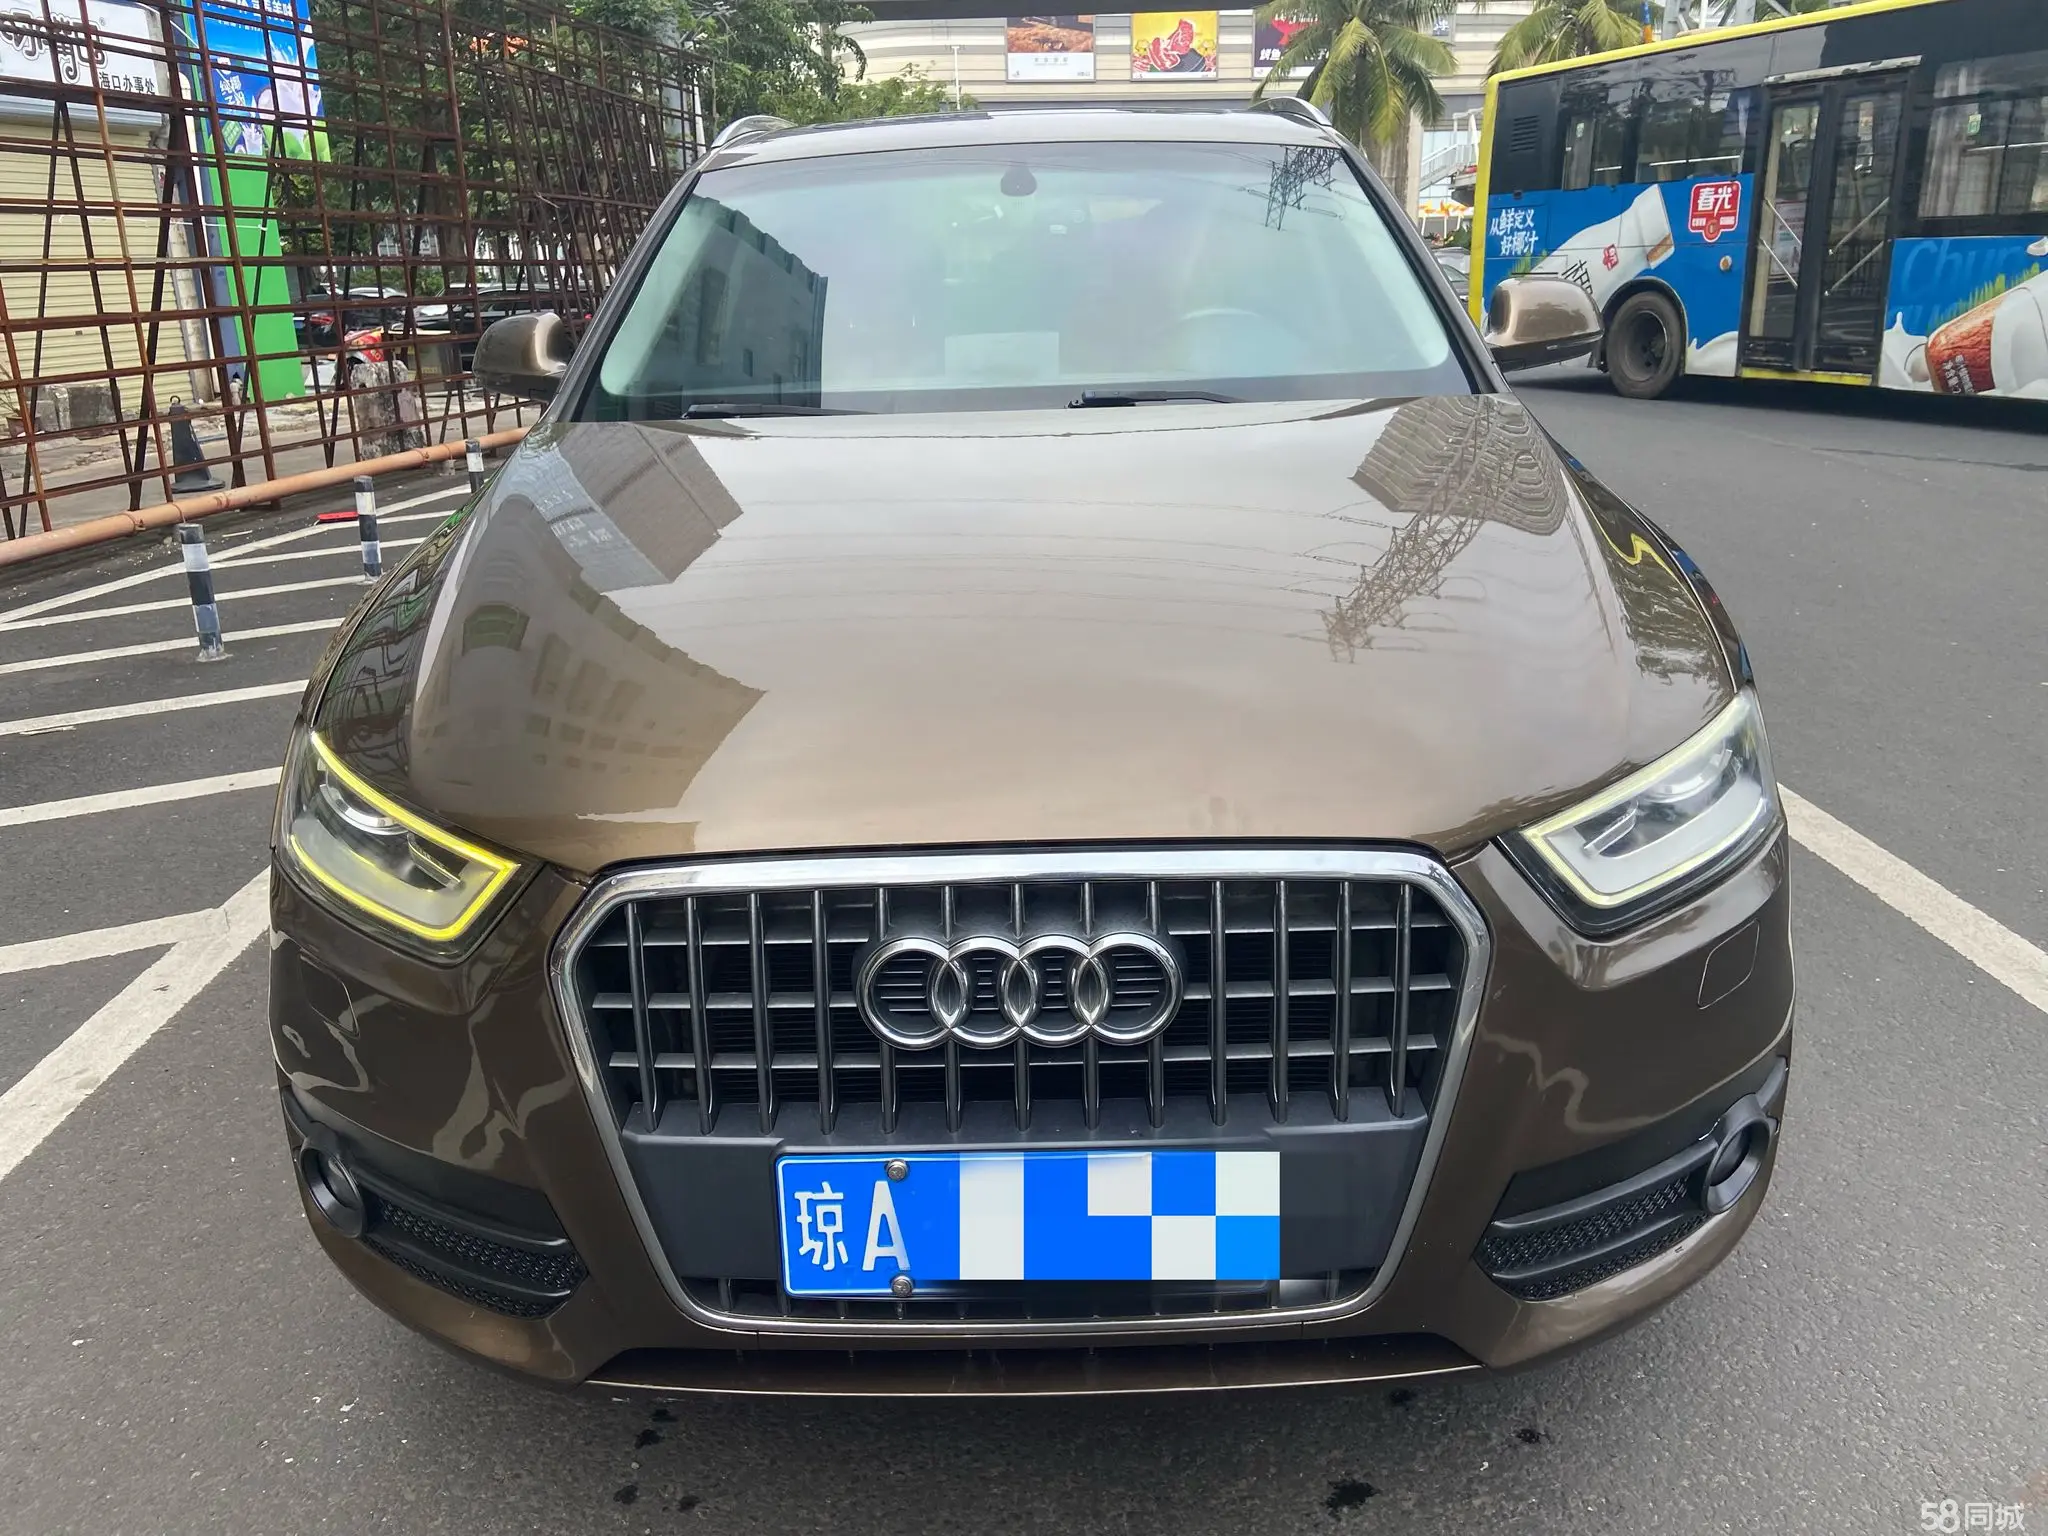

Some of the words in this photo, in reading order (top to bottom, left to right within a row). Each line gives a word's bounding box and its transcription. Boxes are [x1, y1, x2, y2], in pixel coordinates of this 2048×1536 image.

[99, 71, 156, 95] 海口办事处
[1697, 185, 1733, 217] 春光
[1489, 207, 1535, 236] 从鲜定义
[1500, 231, 1539, 257] 好椰汁
